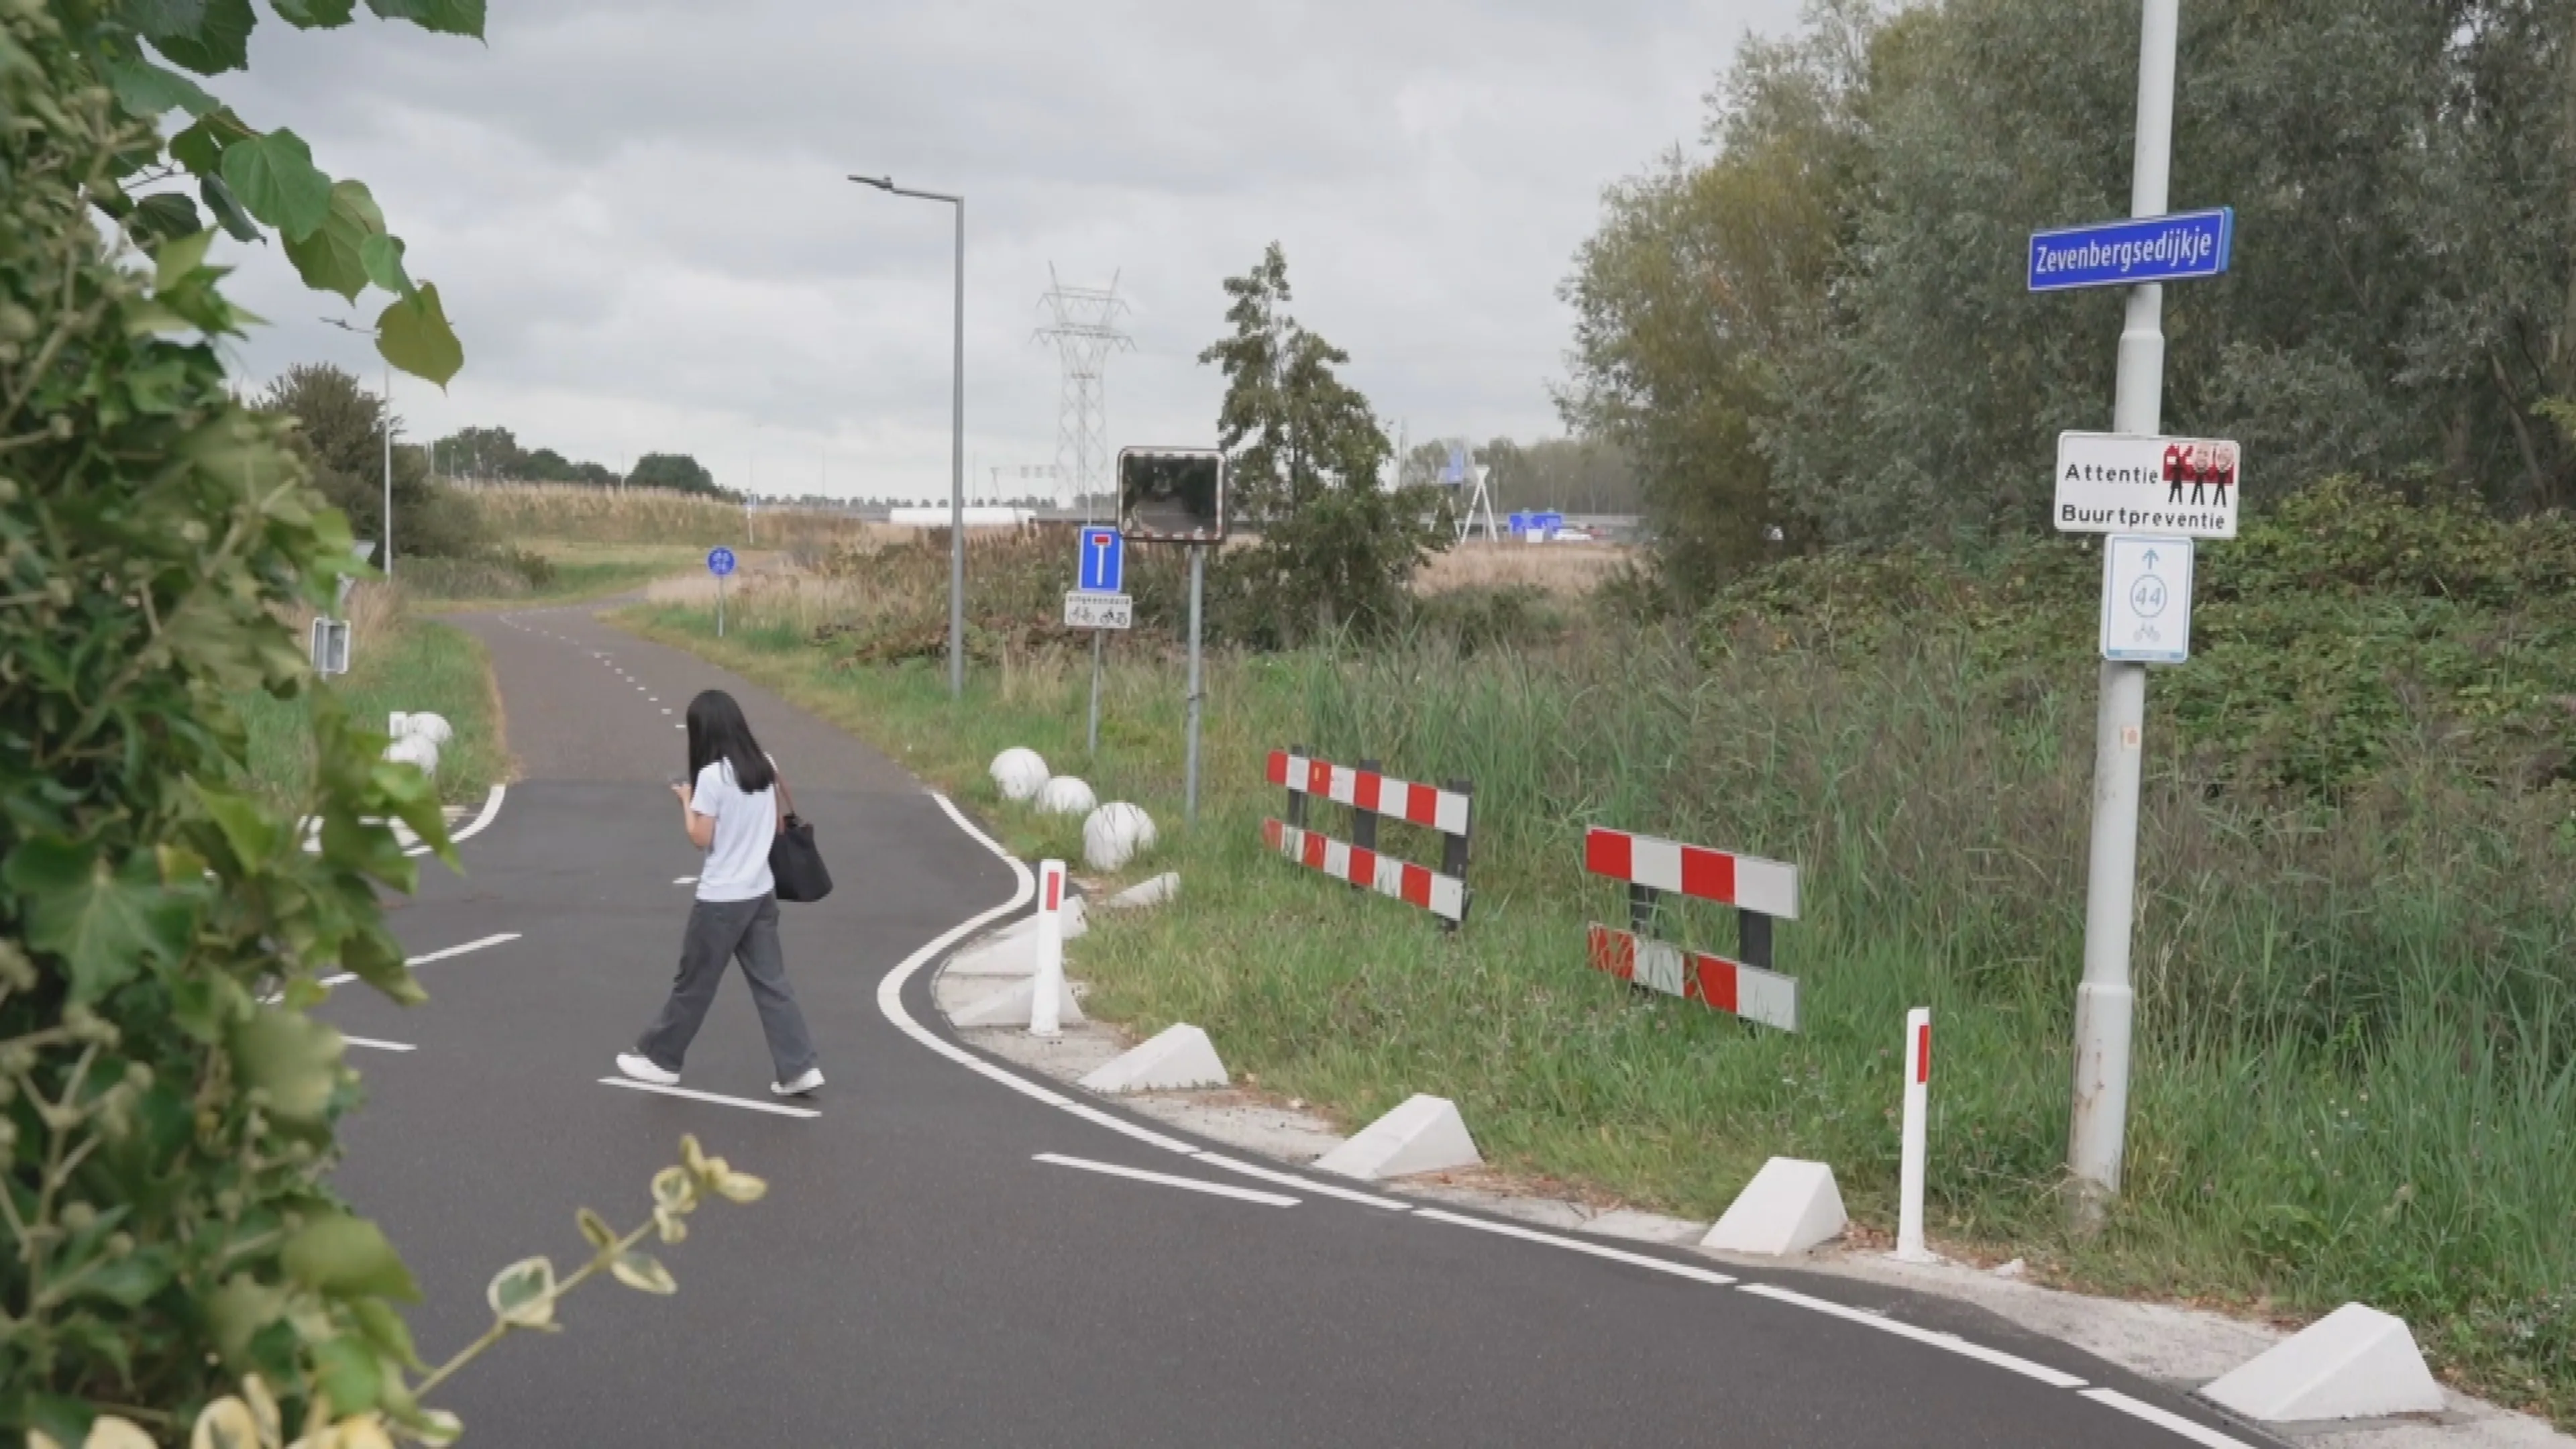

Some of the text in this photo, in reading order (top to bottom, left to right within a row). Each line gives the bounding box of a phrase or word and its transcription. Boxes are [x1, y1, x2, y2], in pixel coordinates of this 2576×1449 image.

[2035, 226, 2212, 274] Zevenbergsedijkje
[2065, 464, 2159, 484] Attentie
[2061, 504, 2225, 529] Buurtpreventie
[2135, 587, 2161, 606] 44
